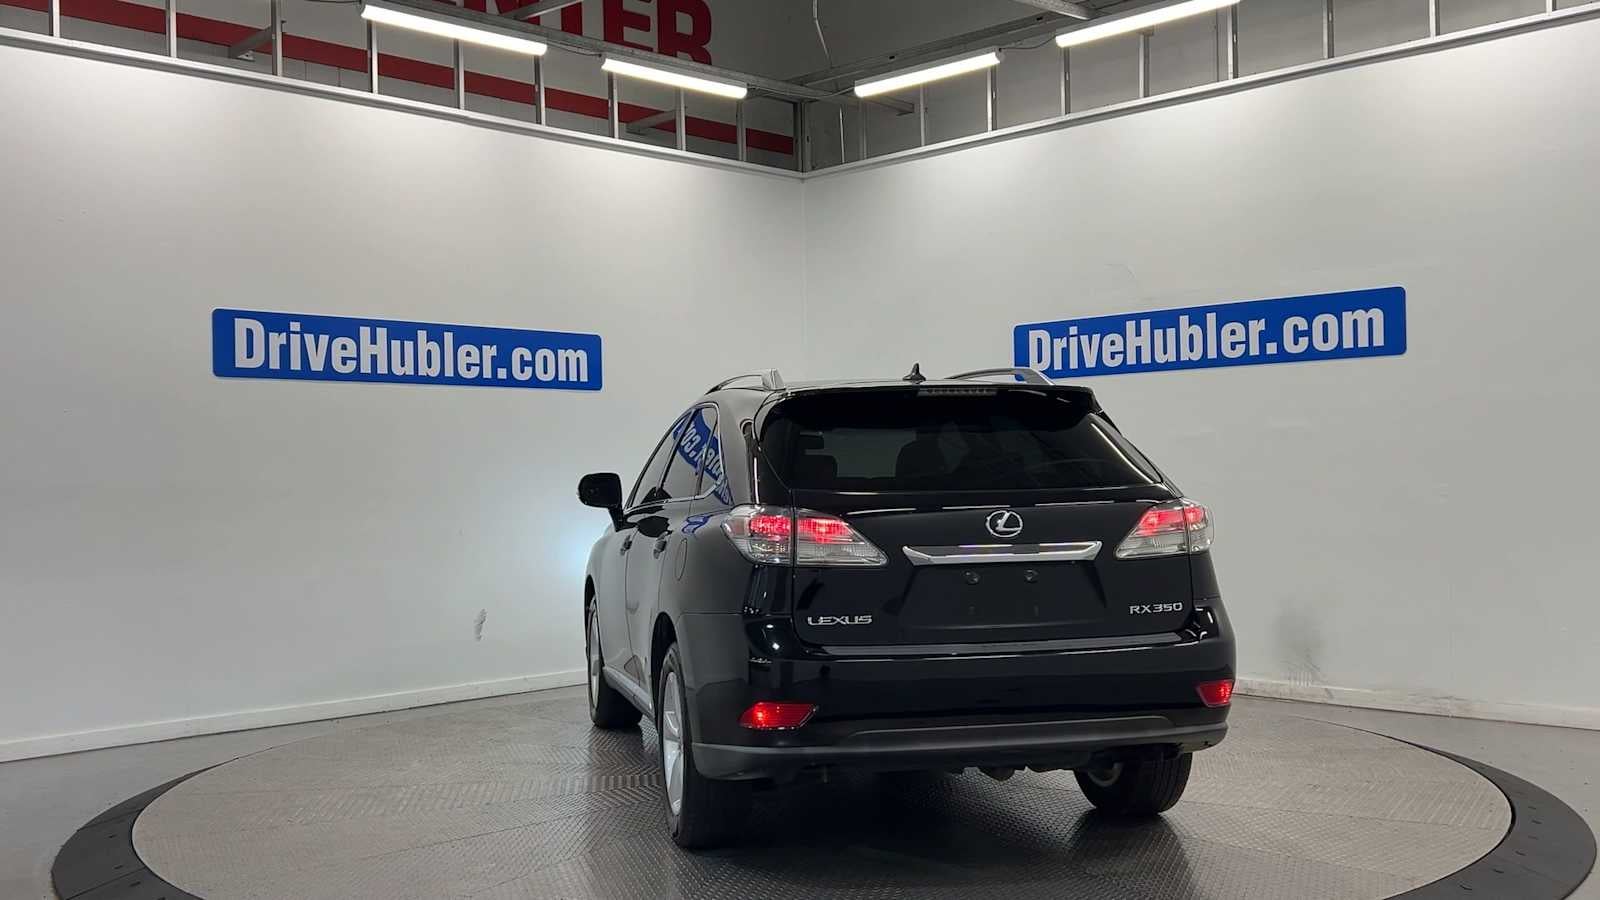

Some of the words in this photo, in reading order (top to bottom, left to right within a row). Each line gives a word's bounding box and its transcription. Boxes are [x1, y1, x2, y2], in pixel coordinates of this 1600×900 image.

[233, 317, 589, 382] DriveHubler.com
[1029, 306, 1385, 371] DriveHubler.com
[807, 614, 873, 626] LEXUS
[1129, 602, 1183, 615] RX350
